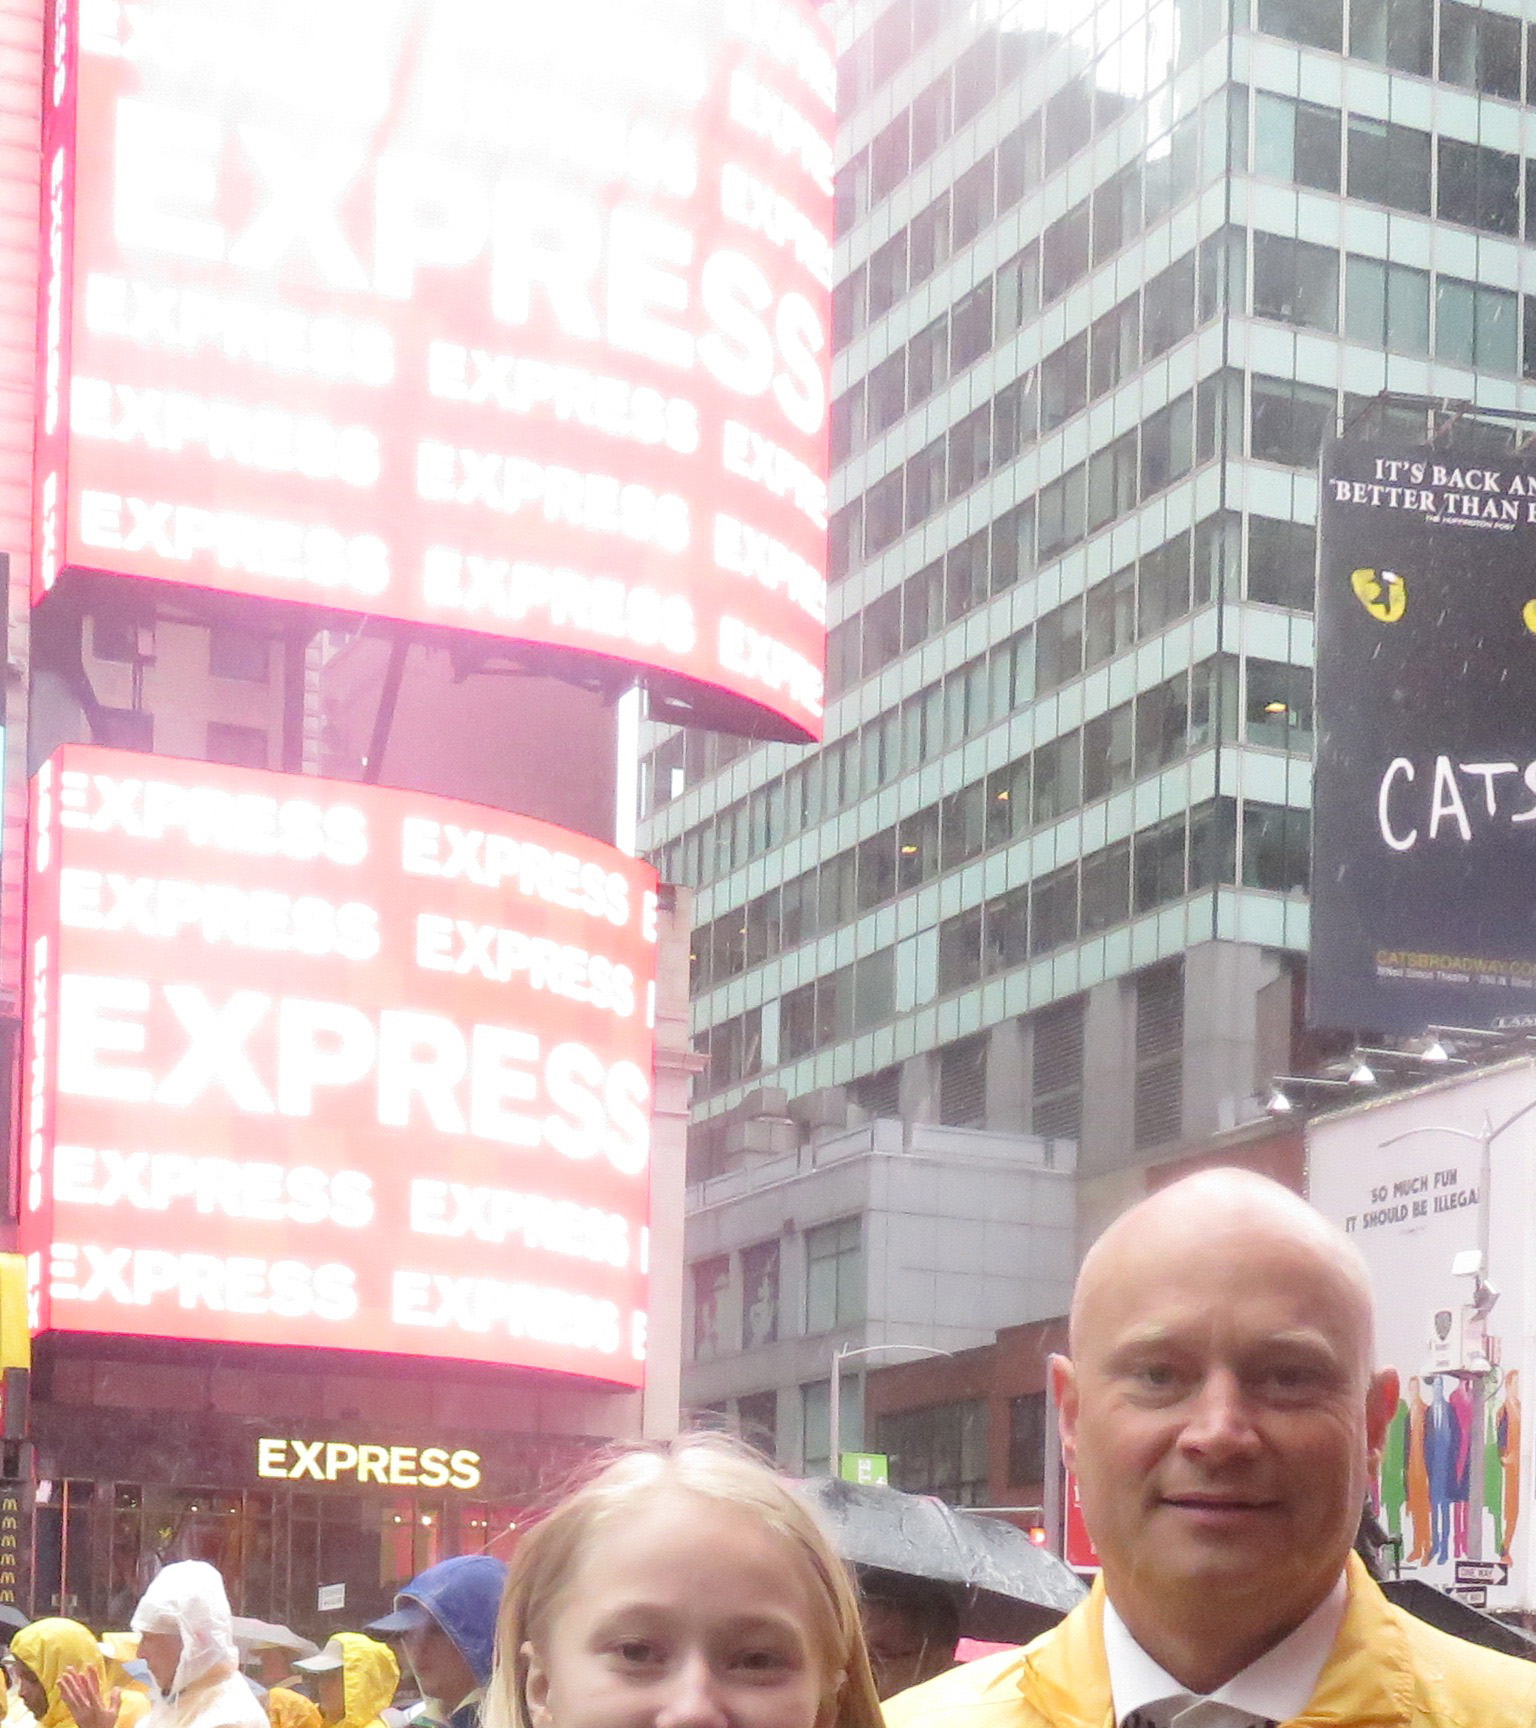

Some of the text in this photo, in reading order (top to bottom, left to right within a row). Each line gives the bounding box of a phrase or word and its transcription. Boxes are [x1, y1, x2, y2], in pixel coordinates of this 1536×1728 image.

[113, 96, 827, 436] EXPRESS
[428, 341, 701, 455] EXPRESS
[417, 440, 690, 552] EXPRESS
[1375, 459, 1425, 485] IT'S
[1432, 465, 1500, 493] BACK
[1443, 493, 1519, 521] THAN
[80, 490, 390, 596] EXPRESS
[425, 546, 696, 655] EXPRESS
[59, 771, 367, 865] EXPRESS
[402, 816, 629, 925] EXPRESS
[60, 868, 379, 960] EXPRESS
[416, 913, 634, 1016] EXPRESS
[56, 972, 650, 1175] EXPRESS
[52, 1146, 375, 1228] EXPRESS
[409, 1177, 629, 1270] EXPRESS
[1345, 1187, 1480, 1233] IT SHOULD BE ILLEGA
[1370, 1169, 1457, 1204] SO MUCH FUN
[49, 1242, 357, 1321] EXPRESS
[390, 1270, 619, 1353] EXPRESS
[258, 1437, 481, 1489] EXPRESS
